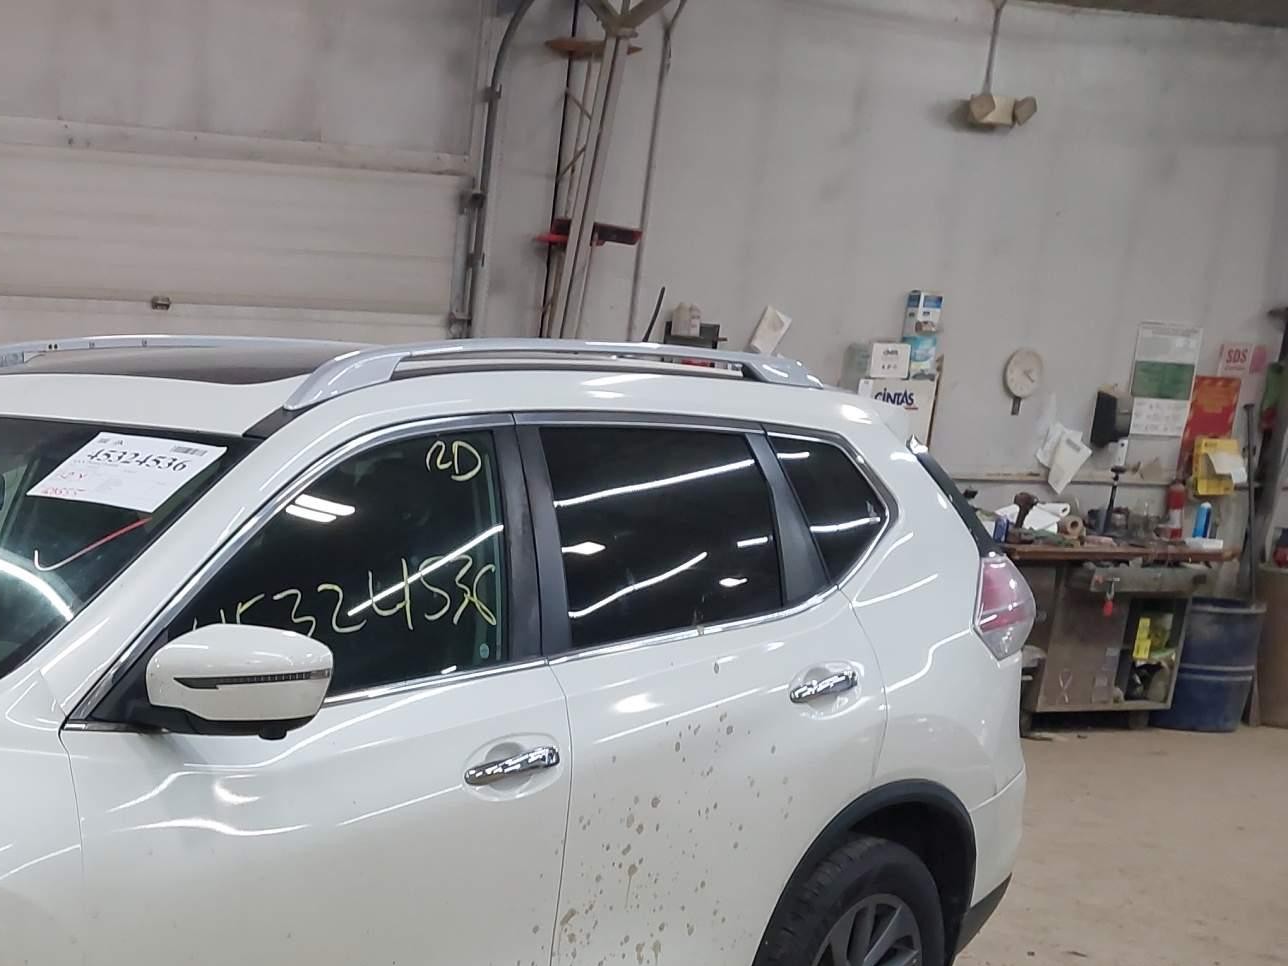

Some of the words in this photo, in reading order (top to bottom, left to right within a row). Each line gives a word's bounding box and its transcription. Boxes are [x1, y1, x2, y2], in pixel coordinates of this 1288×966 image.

[1225, 348, 1249, 364] SDS
[86, 448, 192, 473] 45324536
[192, 554, 497, 638] 324536
